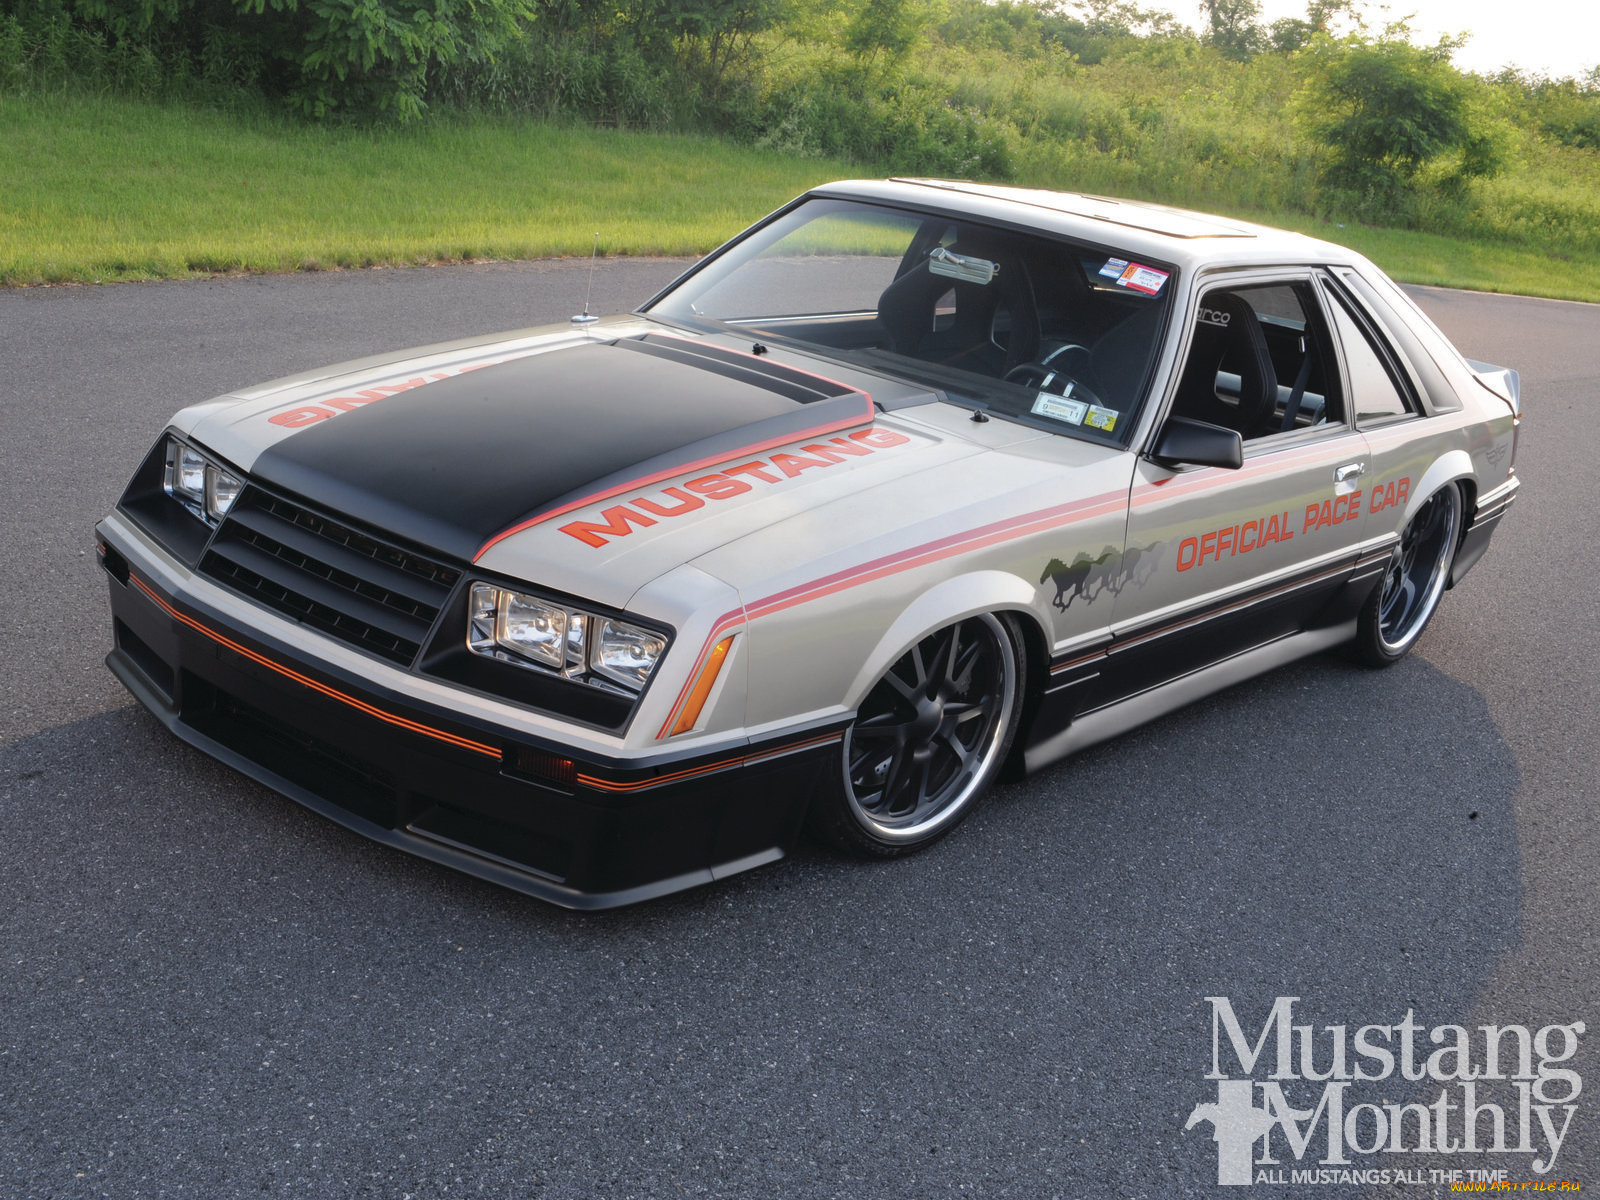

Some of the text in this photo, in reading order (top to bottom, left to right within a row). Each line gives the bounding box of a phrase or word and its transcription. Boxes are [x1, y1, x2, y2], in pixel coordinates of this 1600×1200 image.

[557, 427, 911, 549] MUSTANG
[1176, 476, 1411, 573] OFFICIAL PACE CAR
